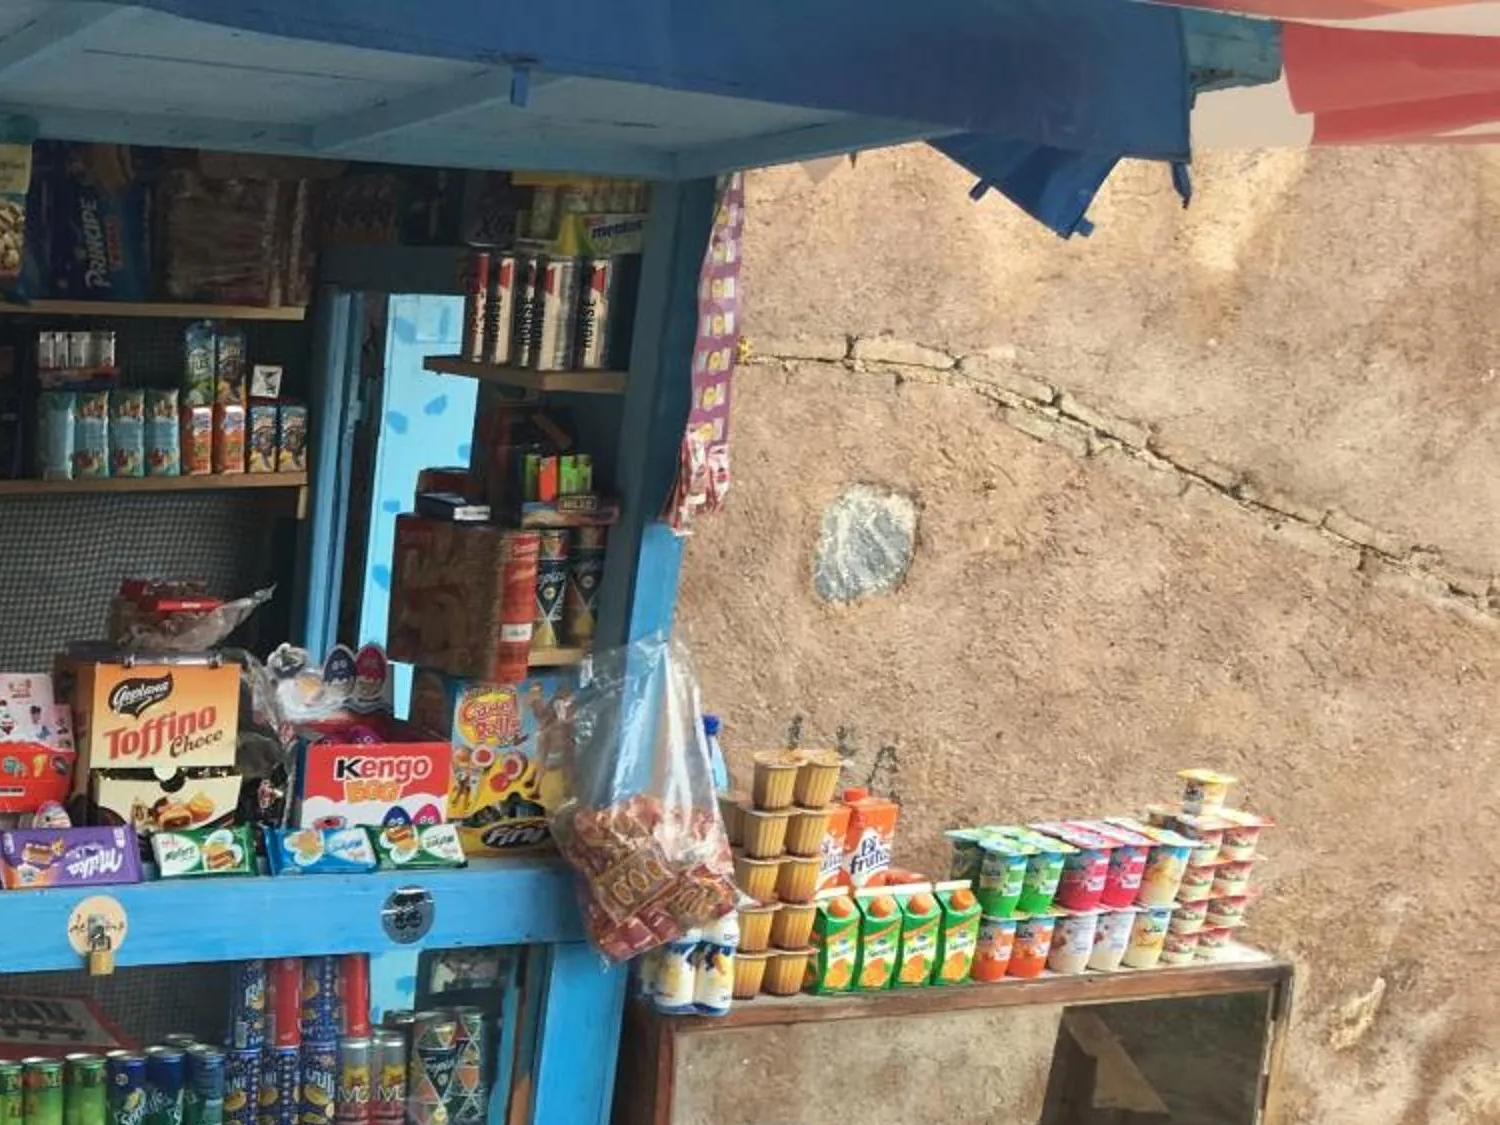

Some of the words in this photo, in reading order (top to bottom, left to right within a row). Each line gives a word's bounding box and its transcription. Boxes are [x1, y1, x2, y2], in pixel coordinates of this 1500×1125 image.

[102, 706, 217, 760] Toffino
[169, 730, 223, 758] Choco
[336, 757, 430, 783] Kengo
[66, 848, 122, 878] Milka
